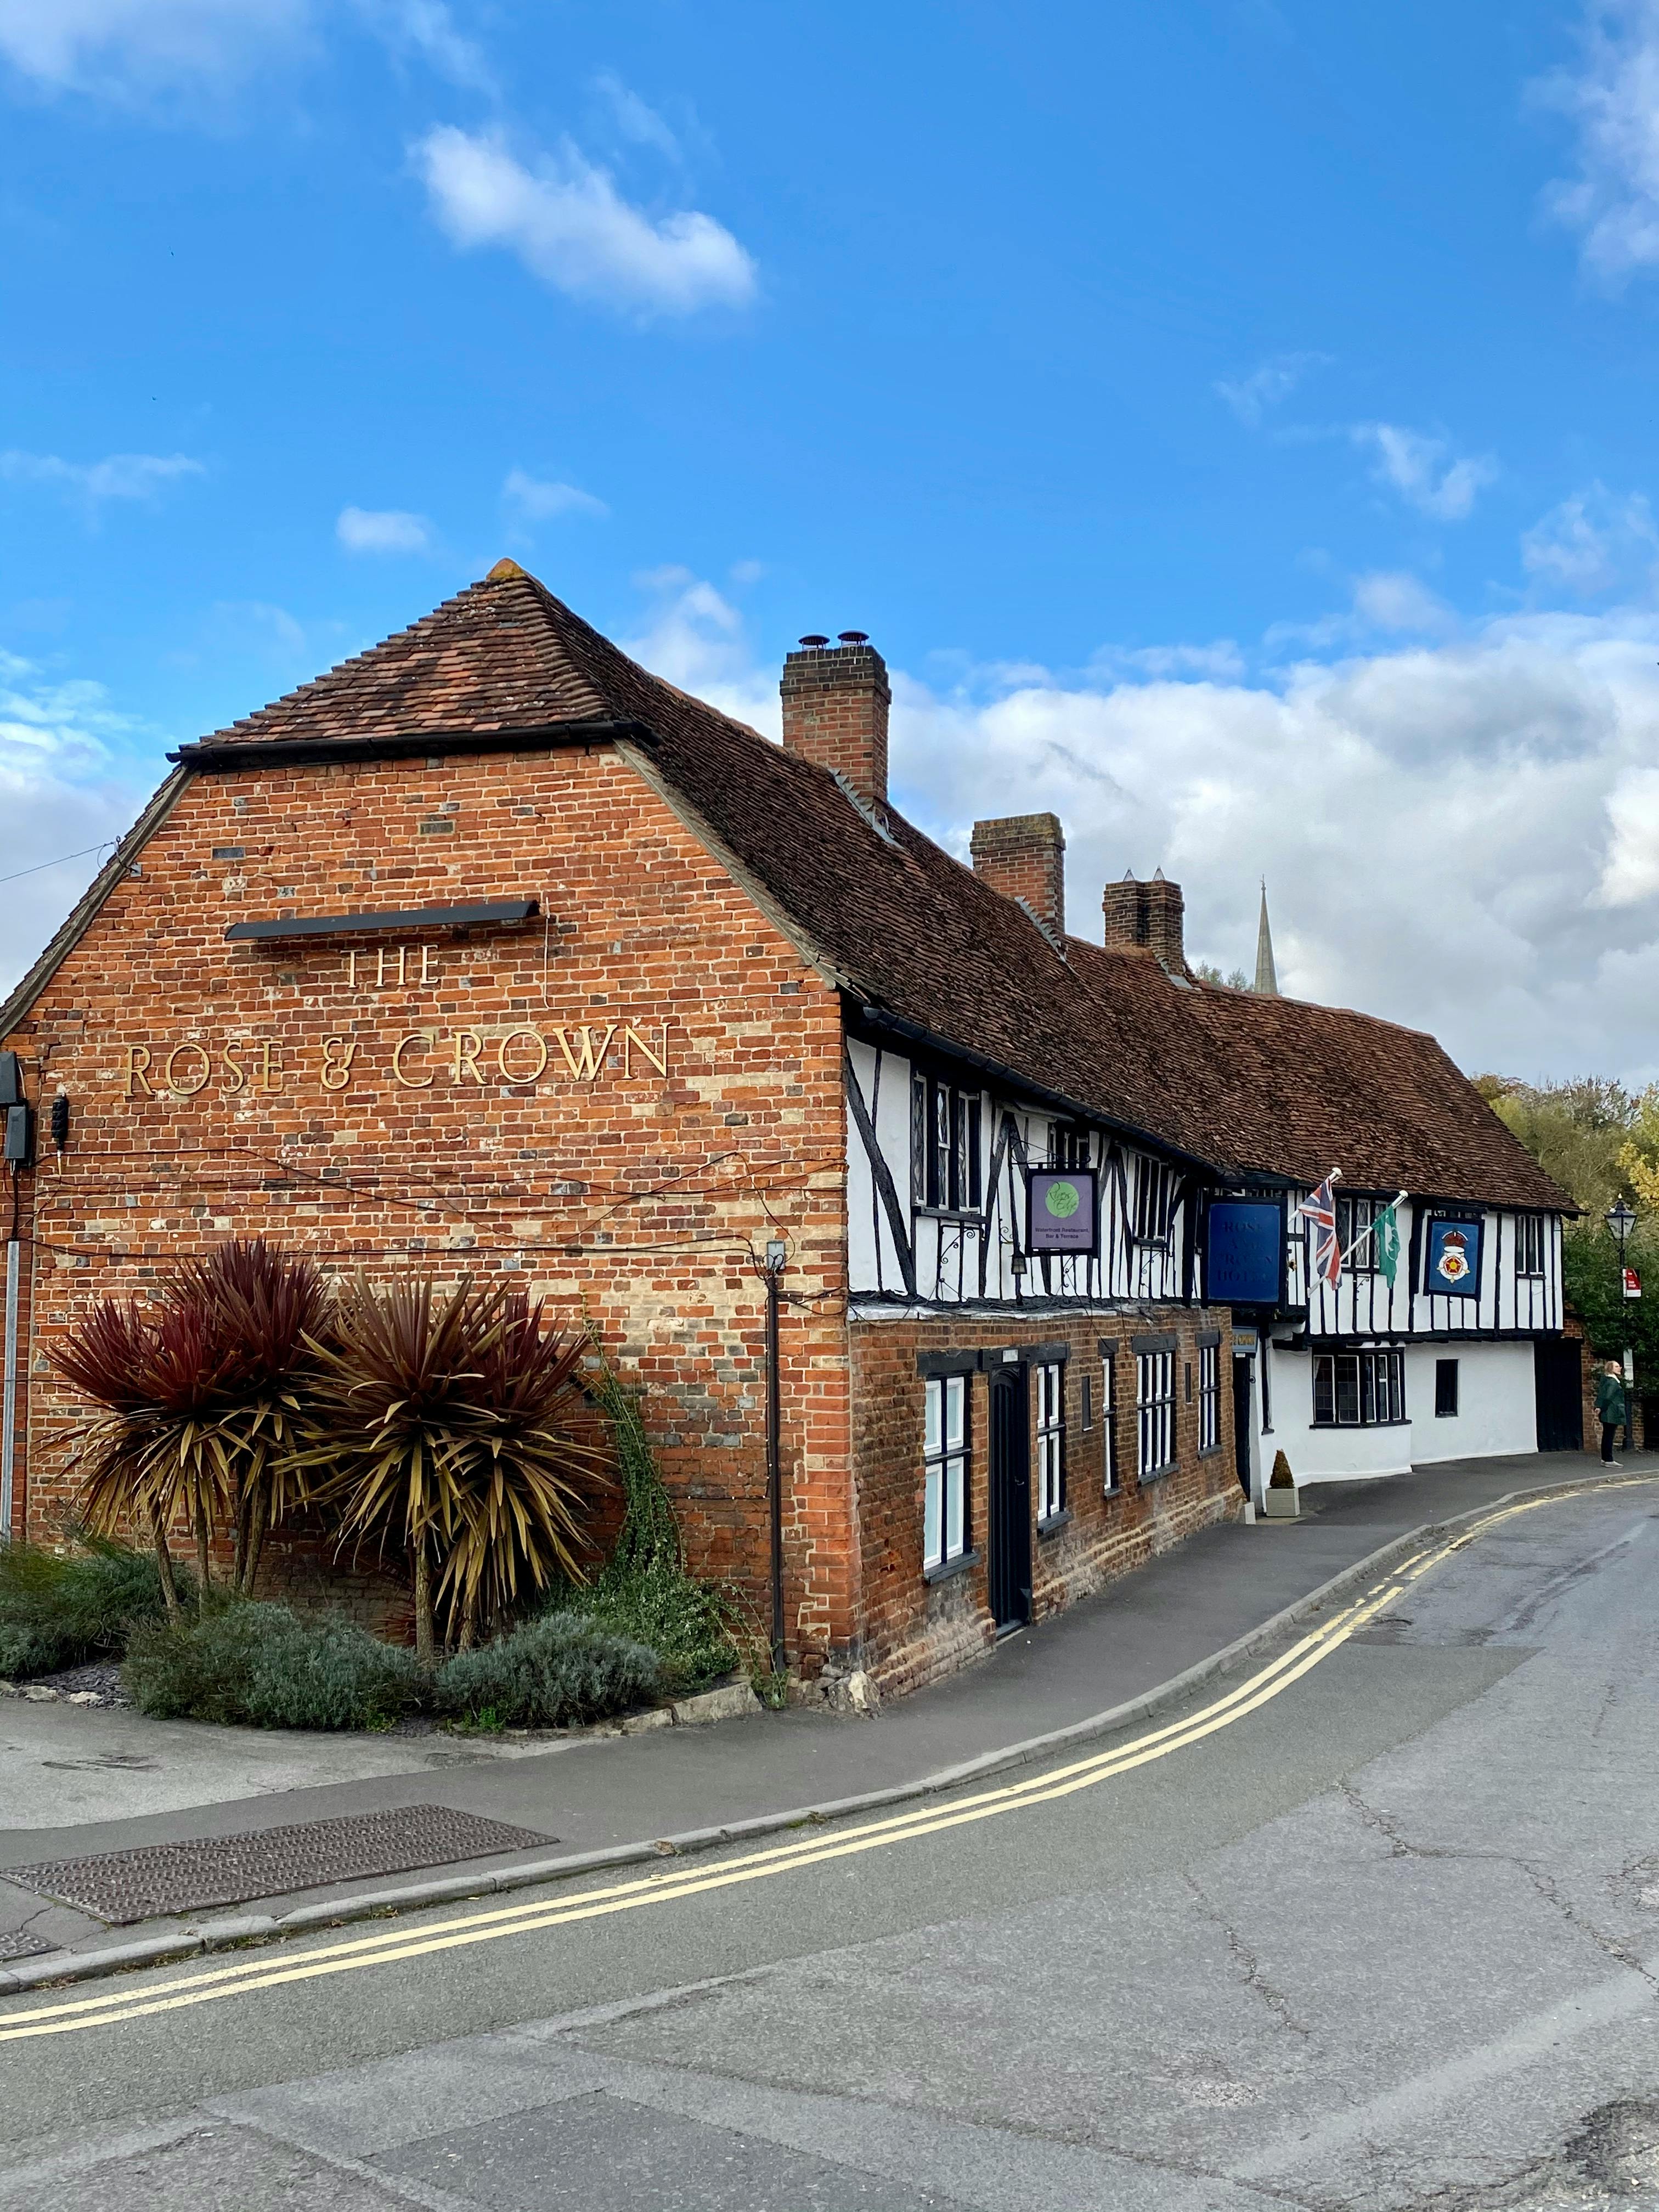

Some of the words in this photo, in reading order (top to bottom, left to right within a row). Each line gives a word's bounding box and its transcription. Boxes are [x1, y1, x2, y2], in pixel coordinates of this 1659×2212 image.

[339, 944, 438, 988] THE
[124, 1040, 284, 1097] ROSE
[320, 1037, 360, 1090] &
[392, 1022, 672, 1088] CROWN
[1223, 1221, 1262, 1232] ROSE
[1216, 1254, 1272, 1266] RON
